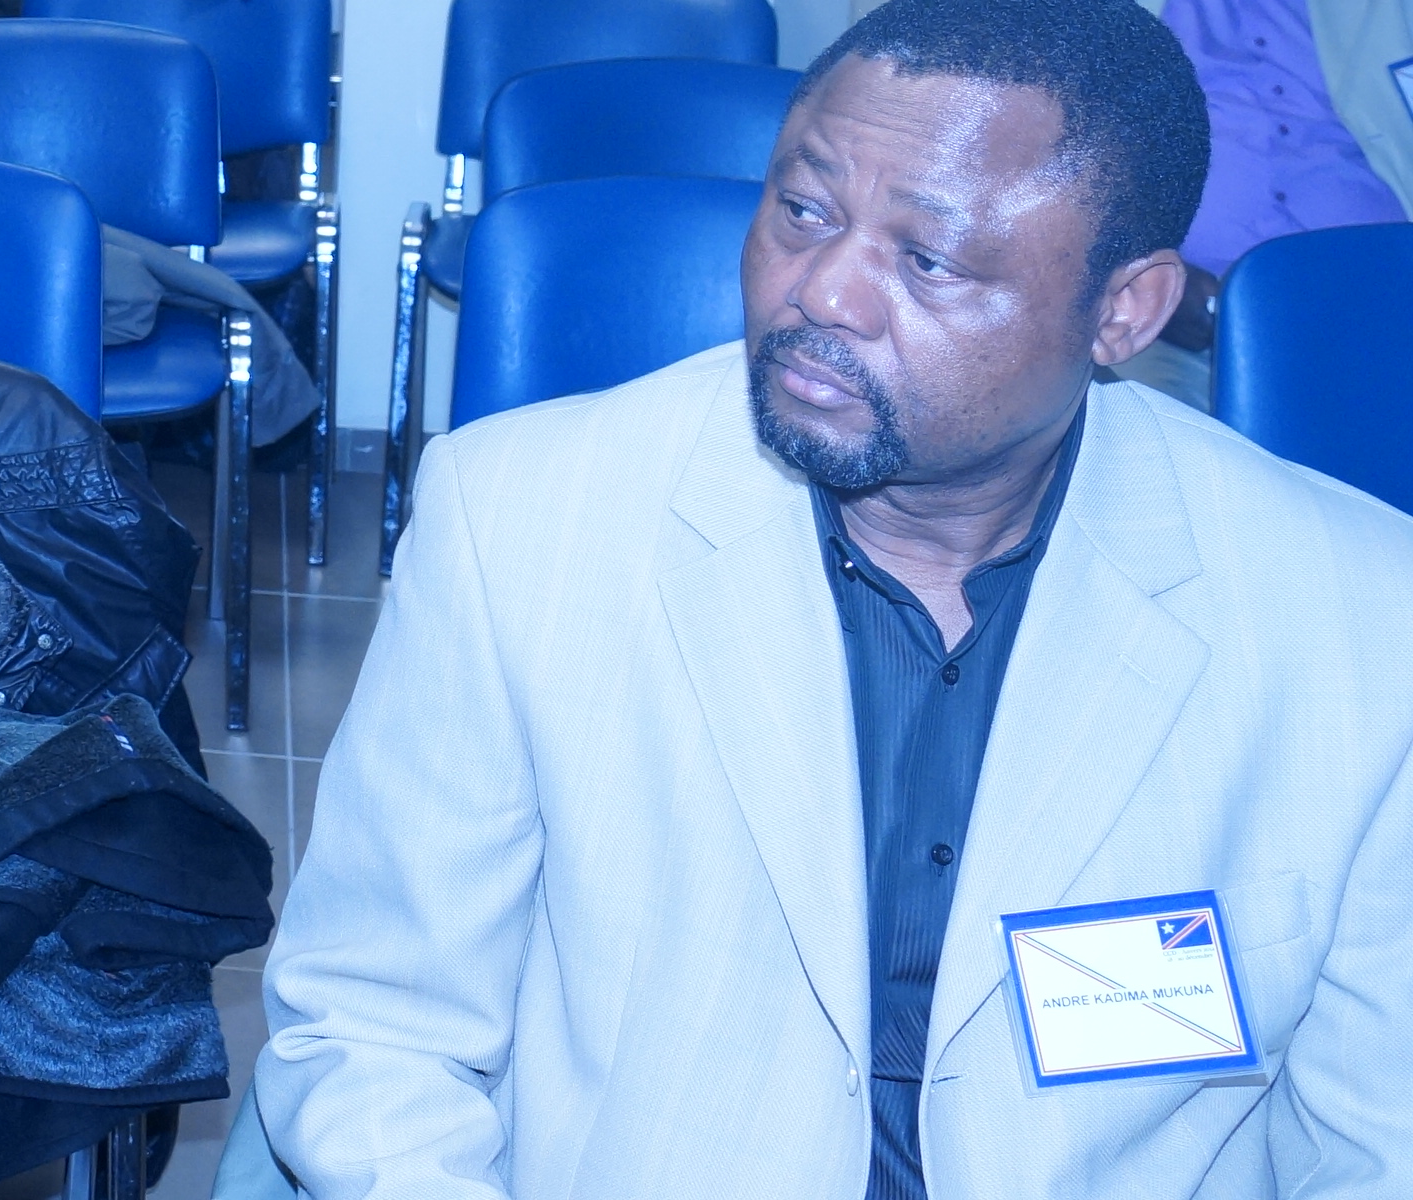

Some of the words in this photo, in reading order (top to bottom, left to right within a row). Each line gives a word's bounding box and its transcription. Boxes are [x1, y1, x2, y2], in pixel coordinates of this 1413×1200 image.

[1041, 994, 1091, 1009] ANDRE
[1093, 990, 1149, 1005] KADIMA
[1152, 983, 1214, 1000] MUKUNA
